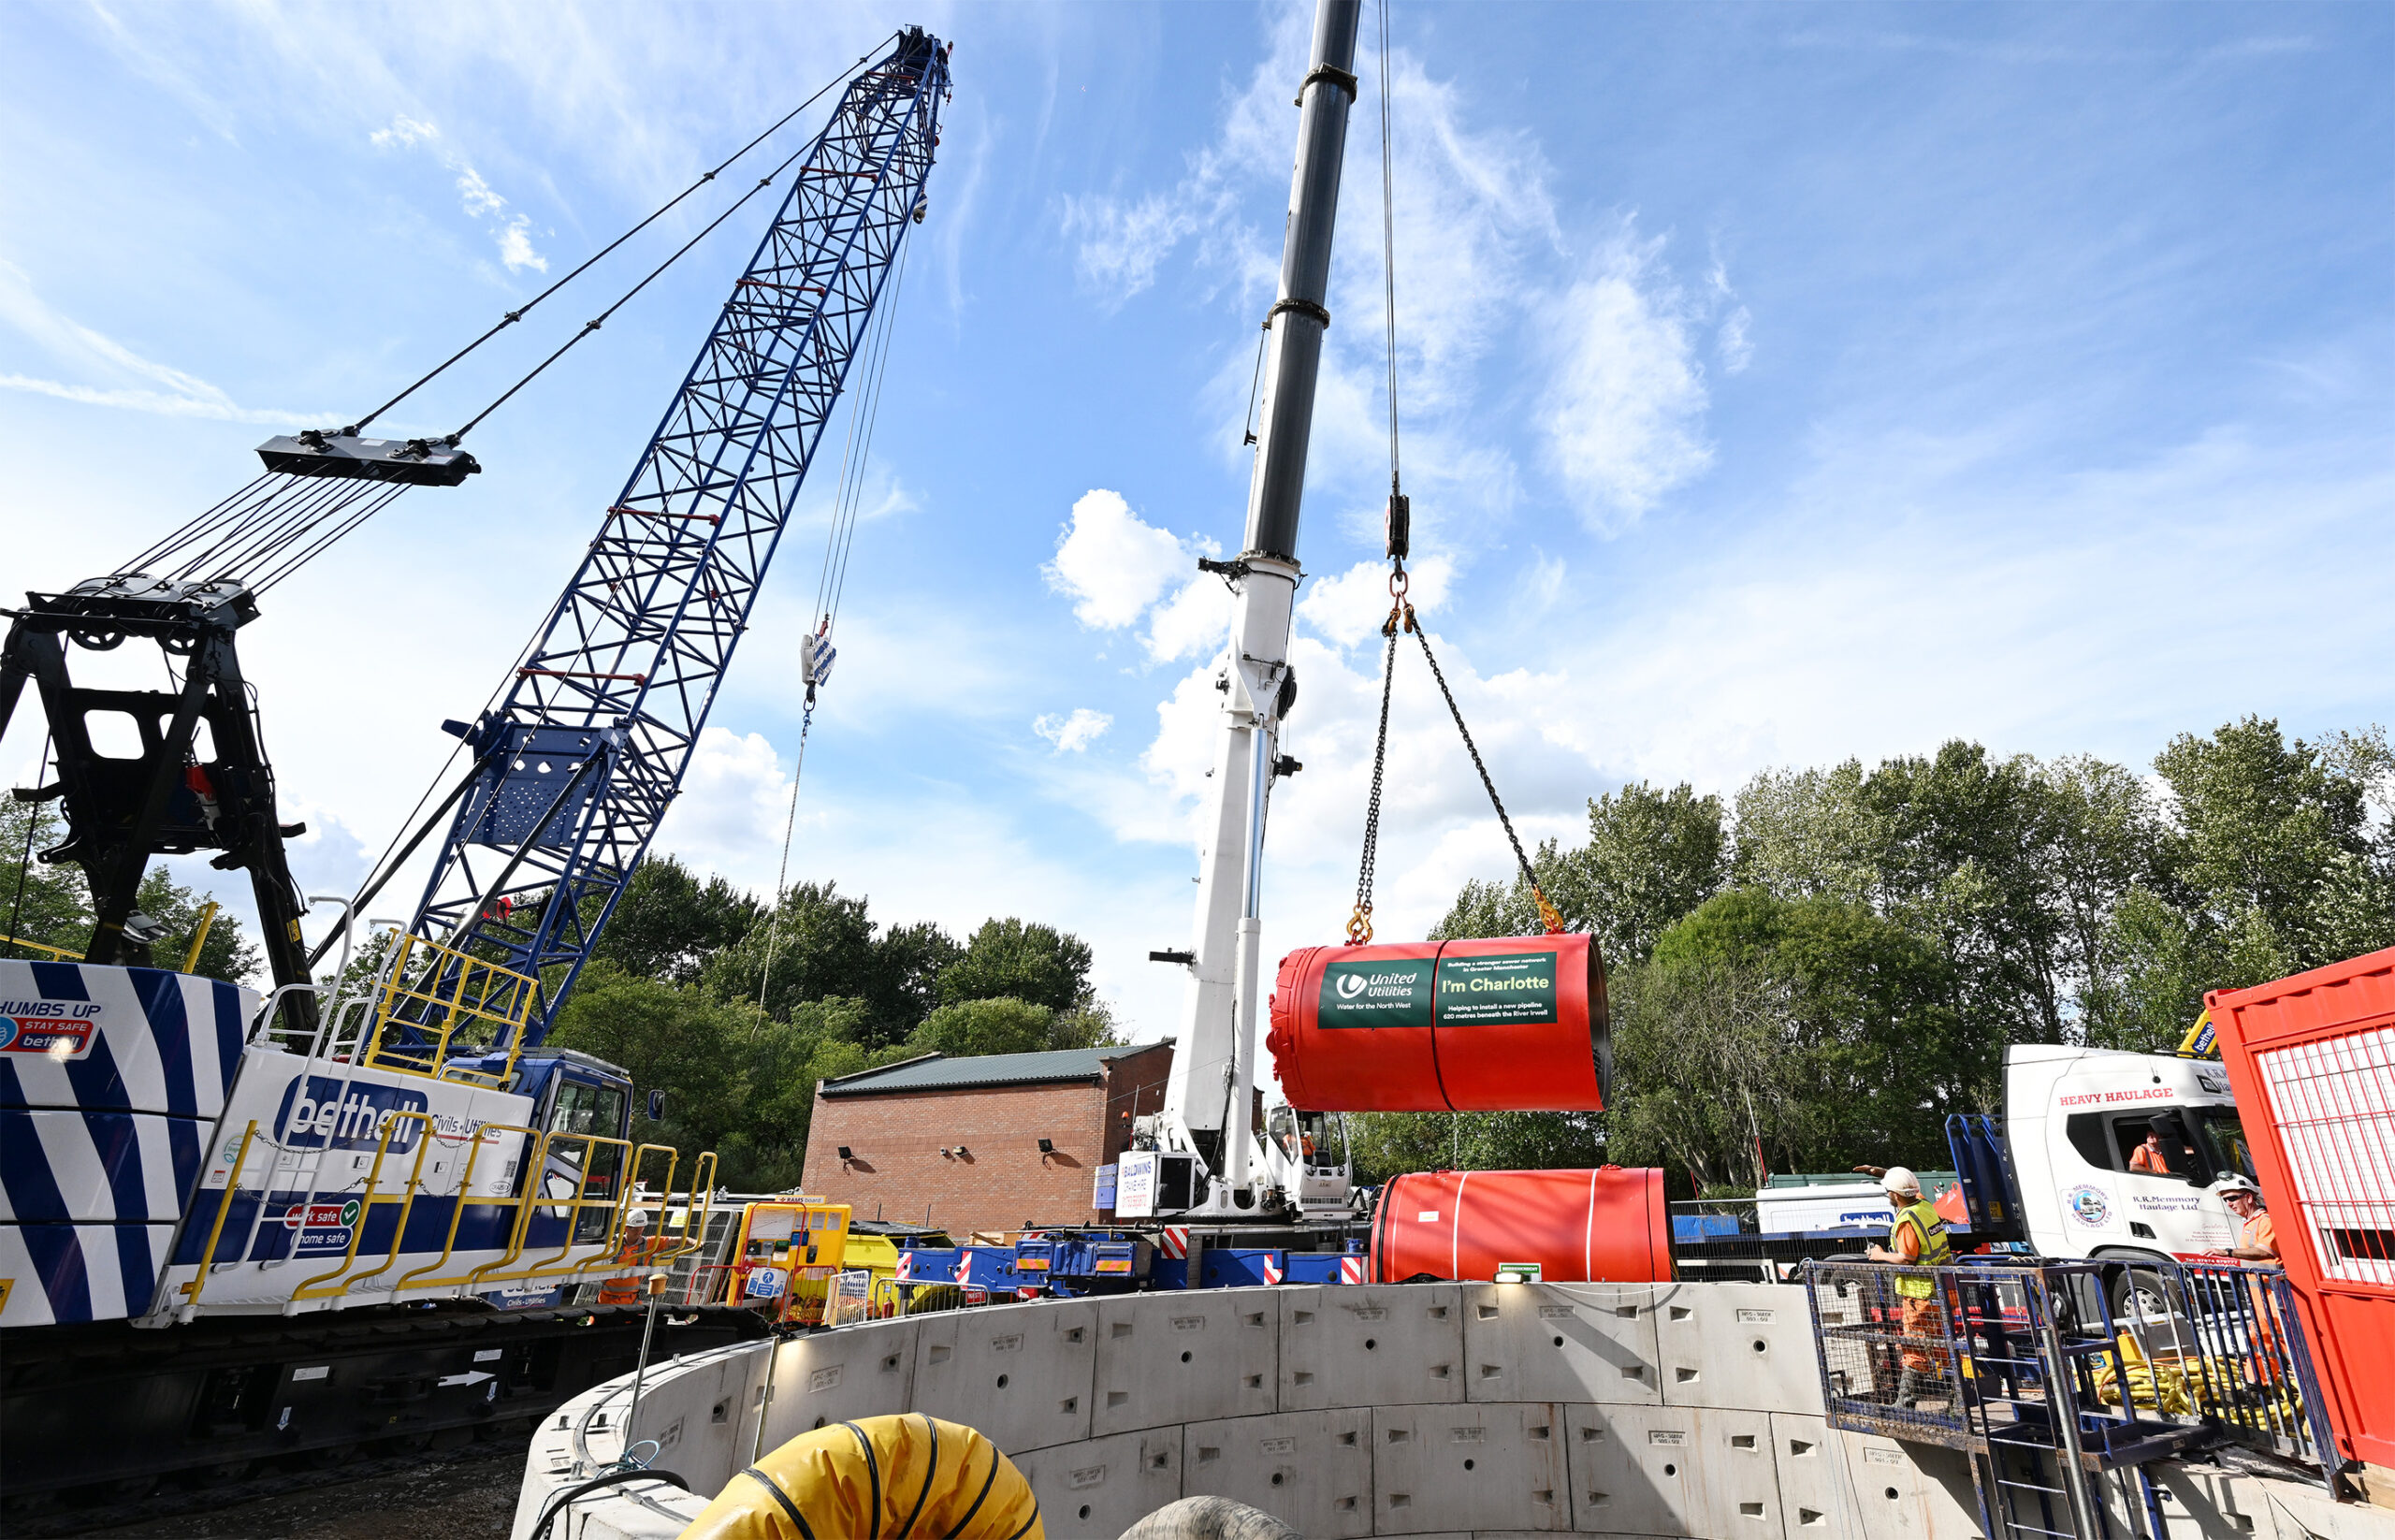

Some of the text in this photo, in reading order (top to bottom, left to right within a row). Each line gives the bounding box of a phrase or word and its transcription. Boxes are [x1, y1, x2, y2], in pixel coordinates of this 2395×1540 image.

[1370, 973, 1417, 985] United
[1470, 976, 1549, 992] Charlotte
[1368, 985, 1413, 997] Utilities
[72, 1004, 101, 1018] UP
[1517, 1002, 1543, 1010] pipeline
[24, 1021, 88, 1031] STAY SAFE
[23, 1035, 80, 1048] bethll
[2060, 1088, 2174, 1106] HEAVY HAULAGE
[290, 1084, 419, 1142] bethell
[431, 1113, 502, 1138] Civils Utiies
[1125, 1161, 1152, 1178] BALDWINS
[2139, 1204, 2178, 1213] Haulage
[292, 1211, 338, 1222] wk safe
[326, 1232, 345, 1244] safe
